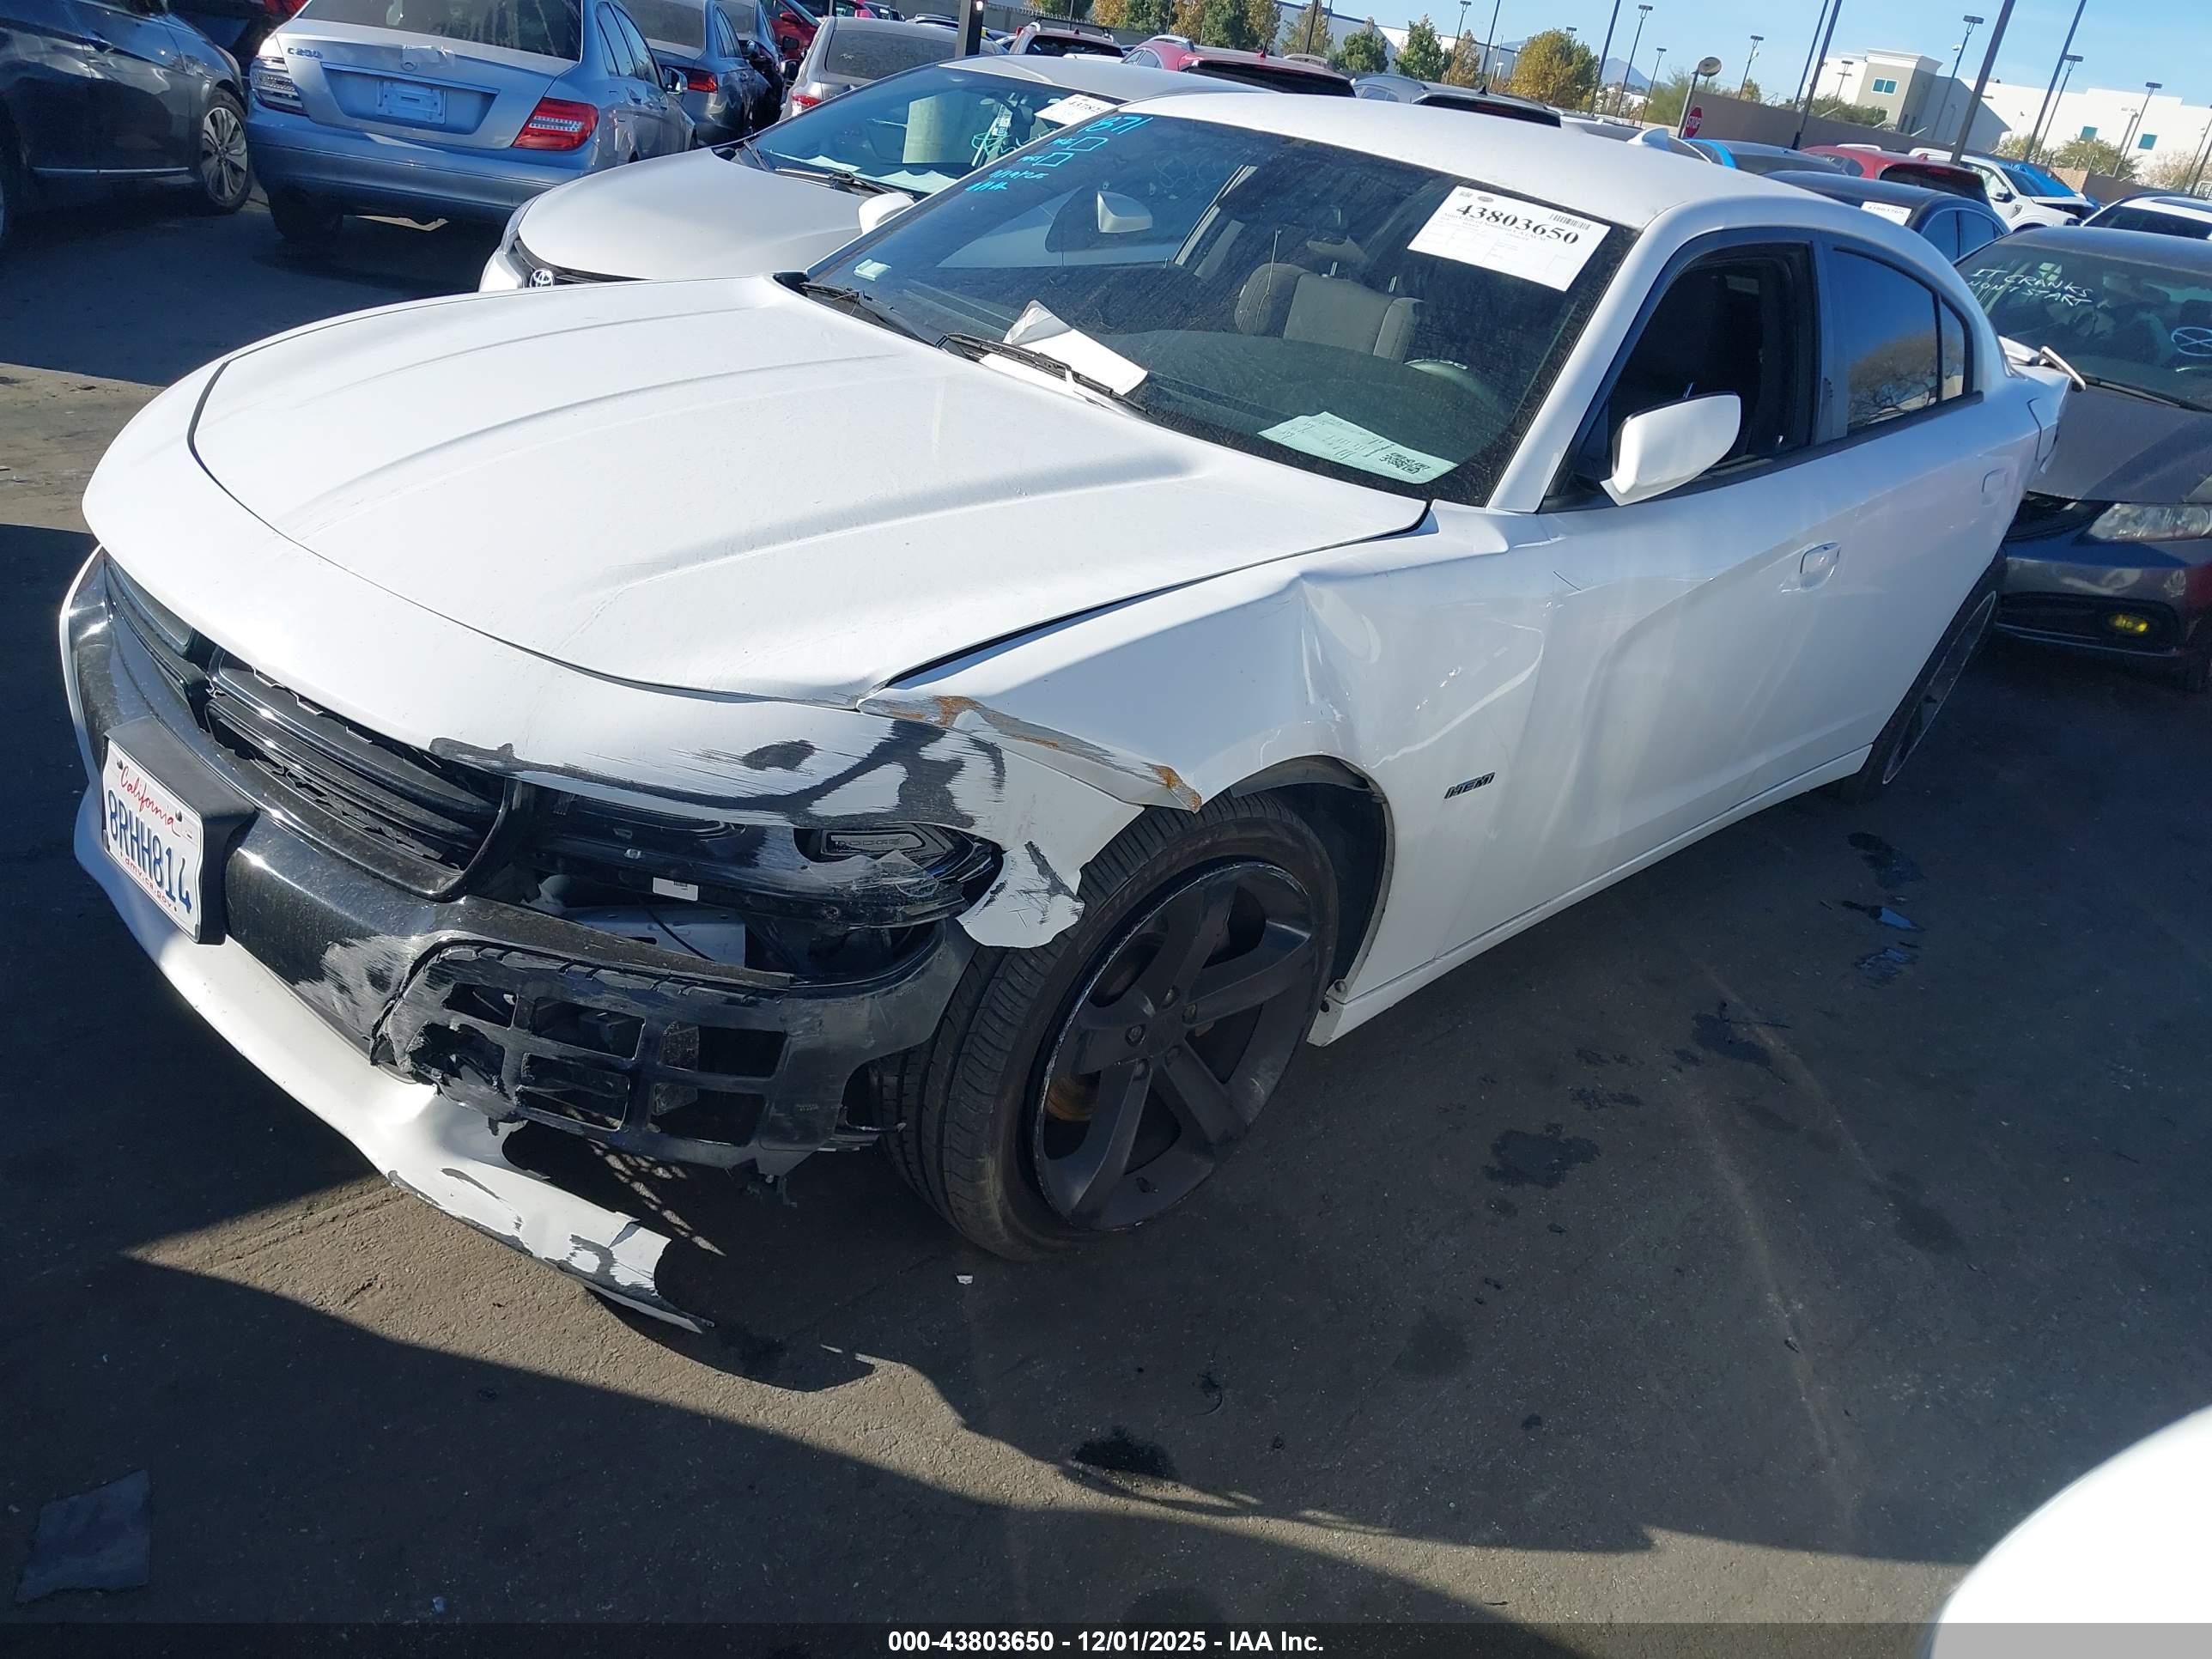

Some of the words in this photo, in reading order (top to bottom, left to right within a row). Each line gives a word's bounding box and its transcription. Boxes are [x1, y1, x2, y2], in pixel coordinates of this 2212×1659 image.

[1456, 204, 1579, 245] 43803650
[1969, 268, 2008, 278] IT
[2004, 274, 2094, 298] CRANKS
[2021, 288, 2093, 307] START
[120, 764, 182, 838] California
[108, 789, 191, 914] 8RHH814
[125, 857, 173, 909] dmv.ca.gov
